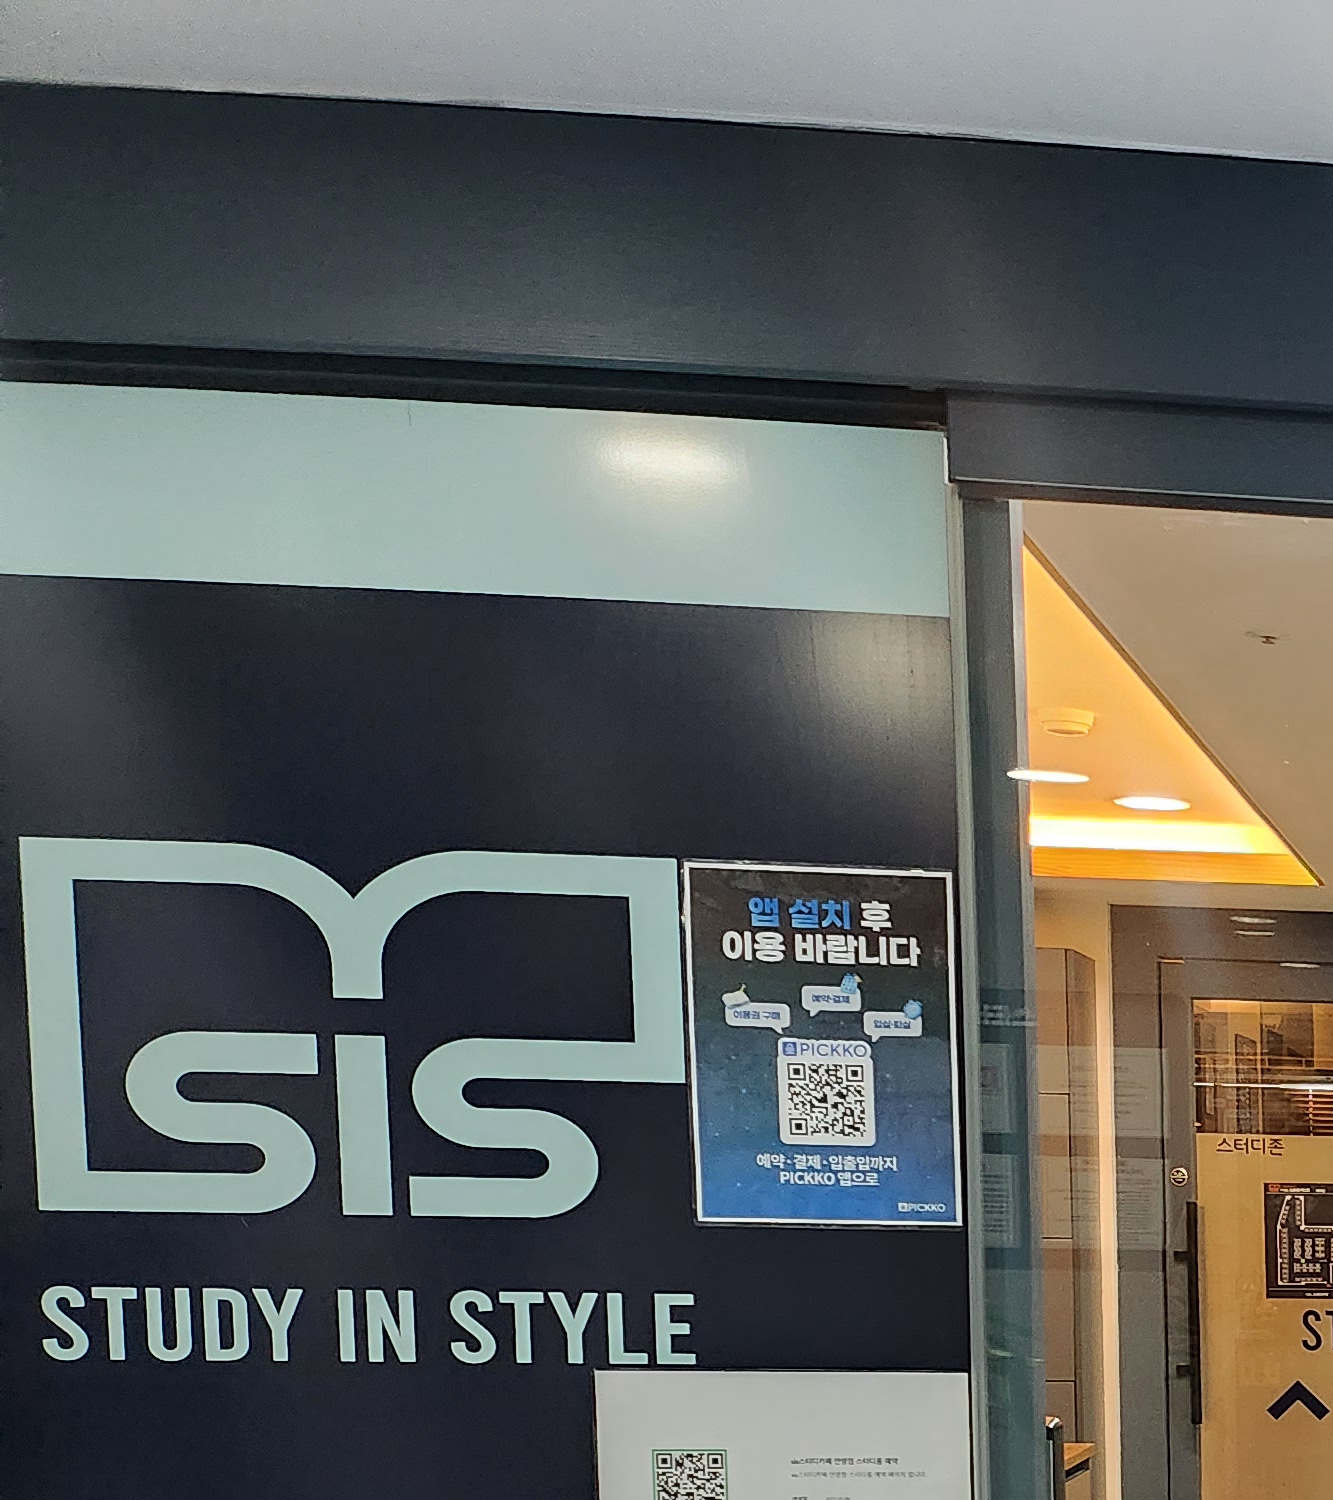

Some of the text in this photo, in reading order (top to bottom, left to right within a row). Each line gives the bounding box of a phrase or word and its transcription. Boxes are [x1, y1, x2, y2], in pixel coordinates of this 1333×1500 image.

[748, 897, 892, 932] 앱 설치 후
[722, 931, 921, 966] 이용 바랍니다
[800, 1042, 868, 1058] PICKKO
[1216, 1137, 1285, 1156] 스터디존
[780, 1172, 880, 1186] PICKKO 앱으로
[909, 1203, 946, 1212] PICKKO
[39, 1285, 697, 1366] STUDY IN STYLE
